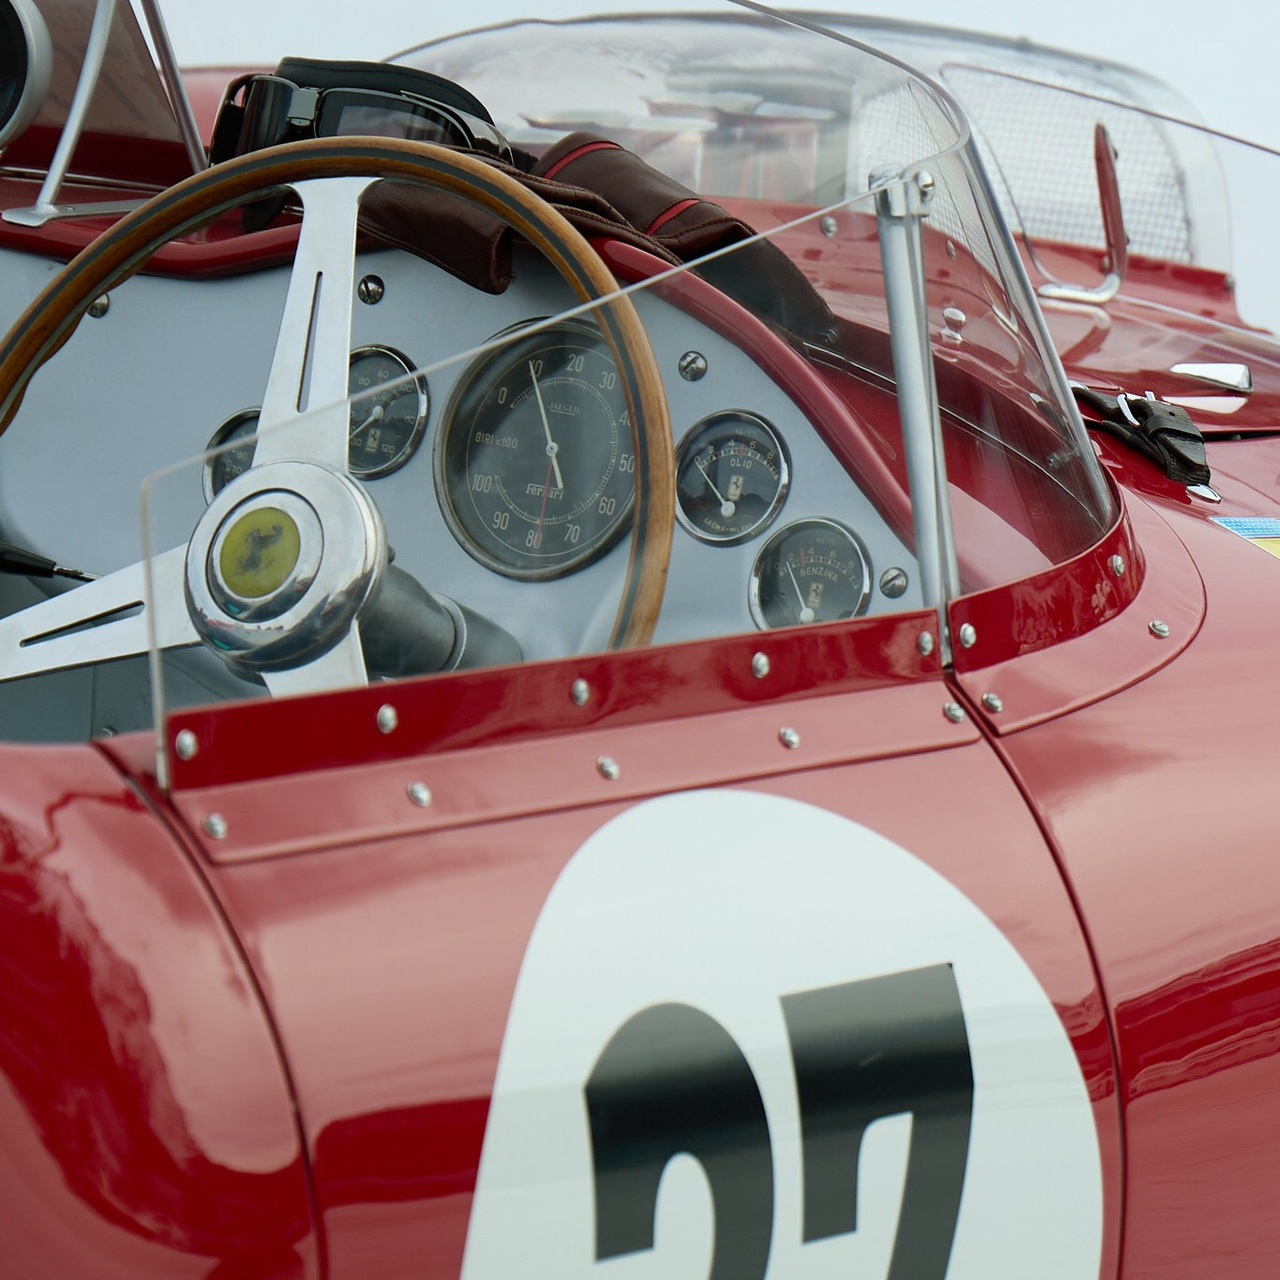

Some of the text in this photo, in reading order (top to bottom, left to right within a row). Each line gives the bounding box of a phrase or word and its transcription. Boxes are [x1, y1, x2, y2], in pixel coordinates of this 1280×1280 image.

[566, 353, 584, 372] 20
[377, 370, 389, 379] 90
[358, 377, 370, 386] 80
[599, 371, 616, 390] 30
[497, 387, 508, 405] 0
[475, 431, 495, 445] GIRI
[728, 438, 735, 447] 4
[381, 443, 396, 454] 120
[708, 445, 715, 454] 2
[749, 440, 756, 449] 6
[236, 450, 248, 460] 80
[767, 451, 775, 460] 8
[619, 455, 634, 473] 50
[730, 458, 752, 469] OLIO
[471, 474, 492, 493] 100
[598, 497, 616, 516] 60
[492, 511, 509, 531] 90
[564, 523, 581, 543] 70
[525, 530, 542, 548] 80
[808, 547, 815, 555] 4
[829, 550, 836, 559] 6
[847, 560, 855, 569] 8
[800, 567, 839, 582] BENZINA
